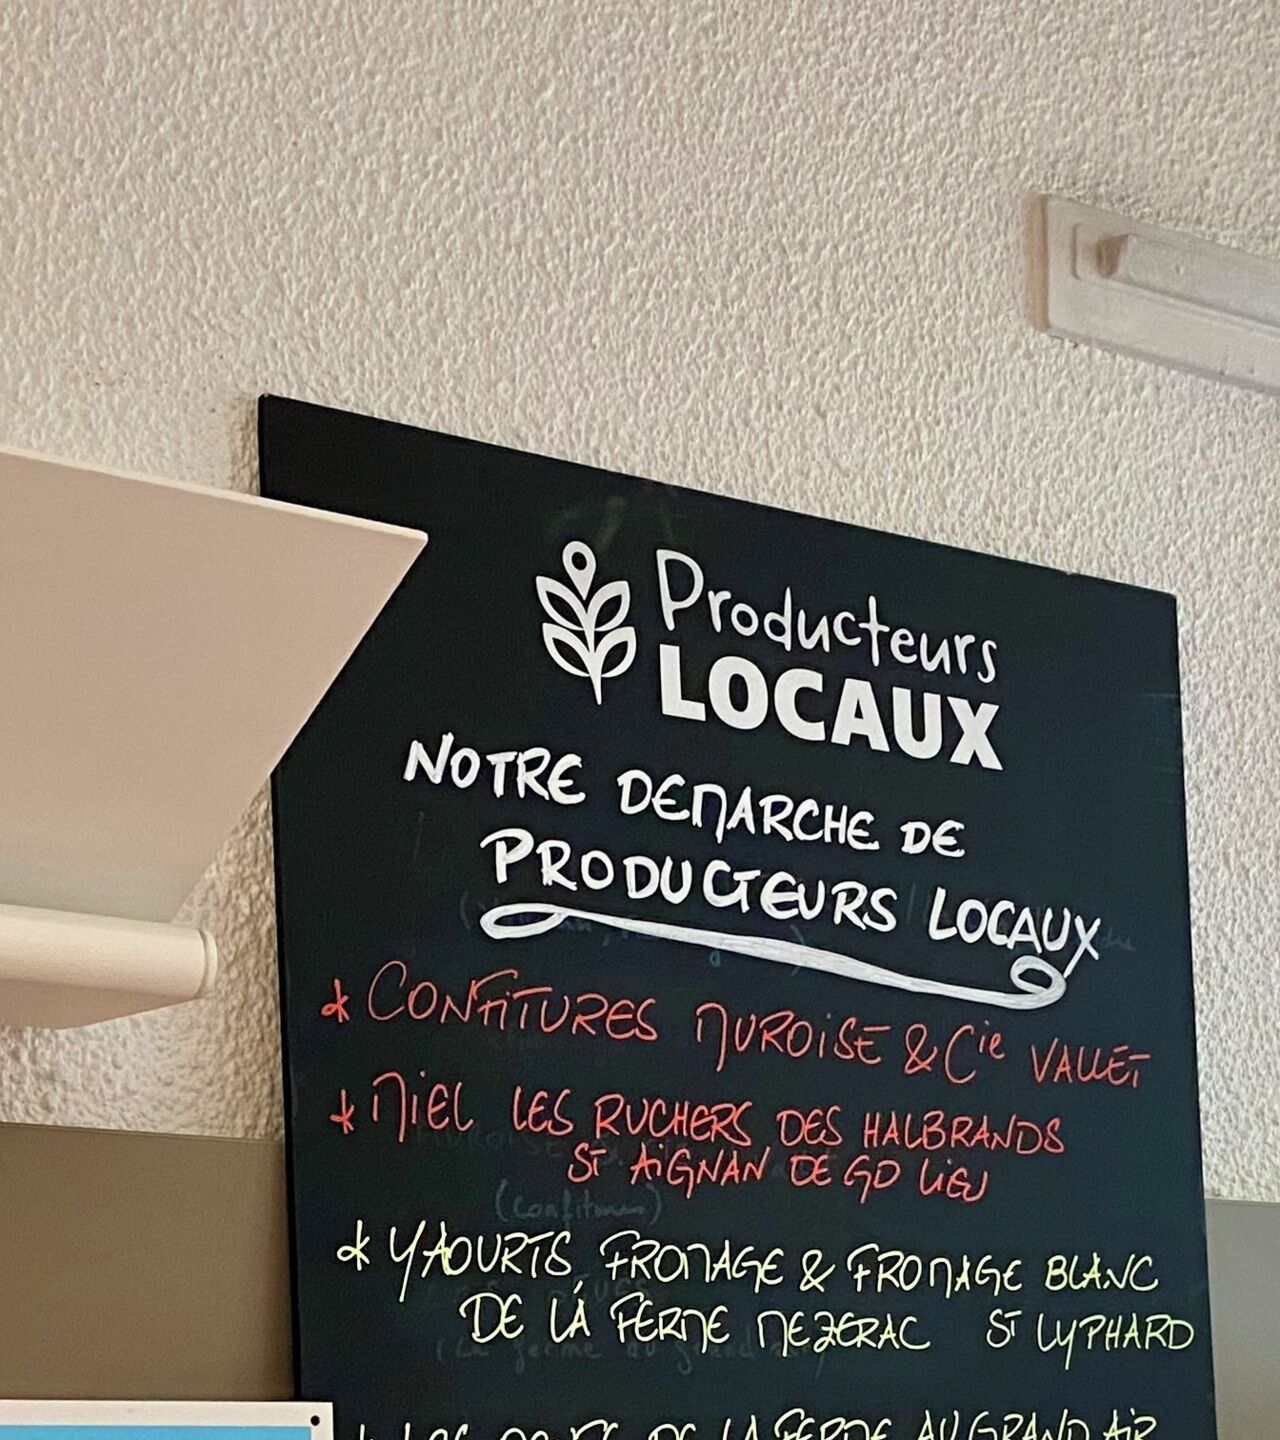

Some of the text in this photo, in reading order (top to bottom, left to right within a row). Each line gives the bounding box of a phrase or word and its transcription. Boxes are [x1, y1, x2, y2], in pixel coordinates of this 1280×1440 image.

[657, 549, 997, 683] Producteurs
[660, 644, 1003, 770] LOCAUX
[404, 732, 965, 857] NOTRE DEMARCHE DE
[480, 828, 898, 932] PRODUCTEURS
[927, 887, 1101, 977] LOCAUX
[513, 1086, 573, 1135] LES
[595, 1094, 752, 1149] RUCHERS
[777, 1106, 842, 1146] DES
[864, 1111, 1064, 1154] HALBRANDS
[790, 1155, 831, 1186] DE
[600, 1230, 784, 1293] FROMAGE
[800, 1250, 835, 1292] &
[847, 1243, 1022, 1298] FROMAGE
[1045, 1252, 1158, 1291] BLANC
[459, 1293, 524, 1343] DE
[610, 1292, 729, 1353] FERME
